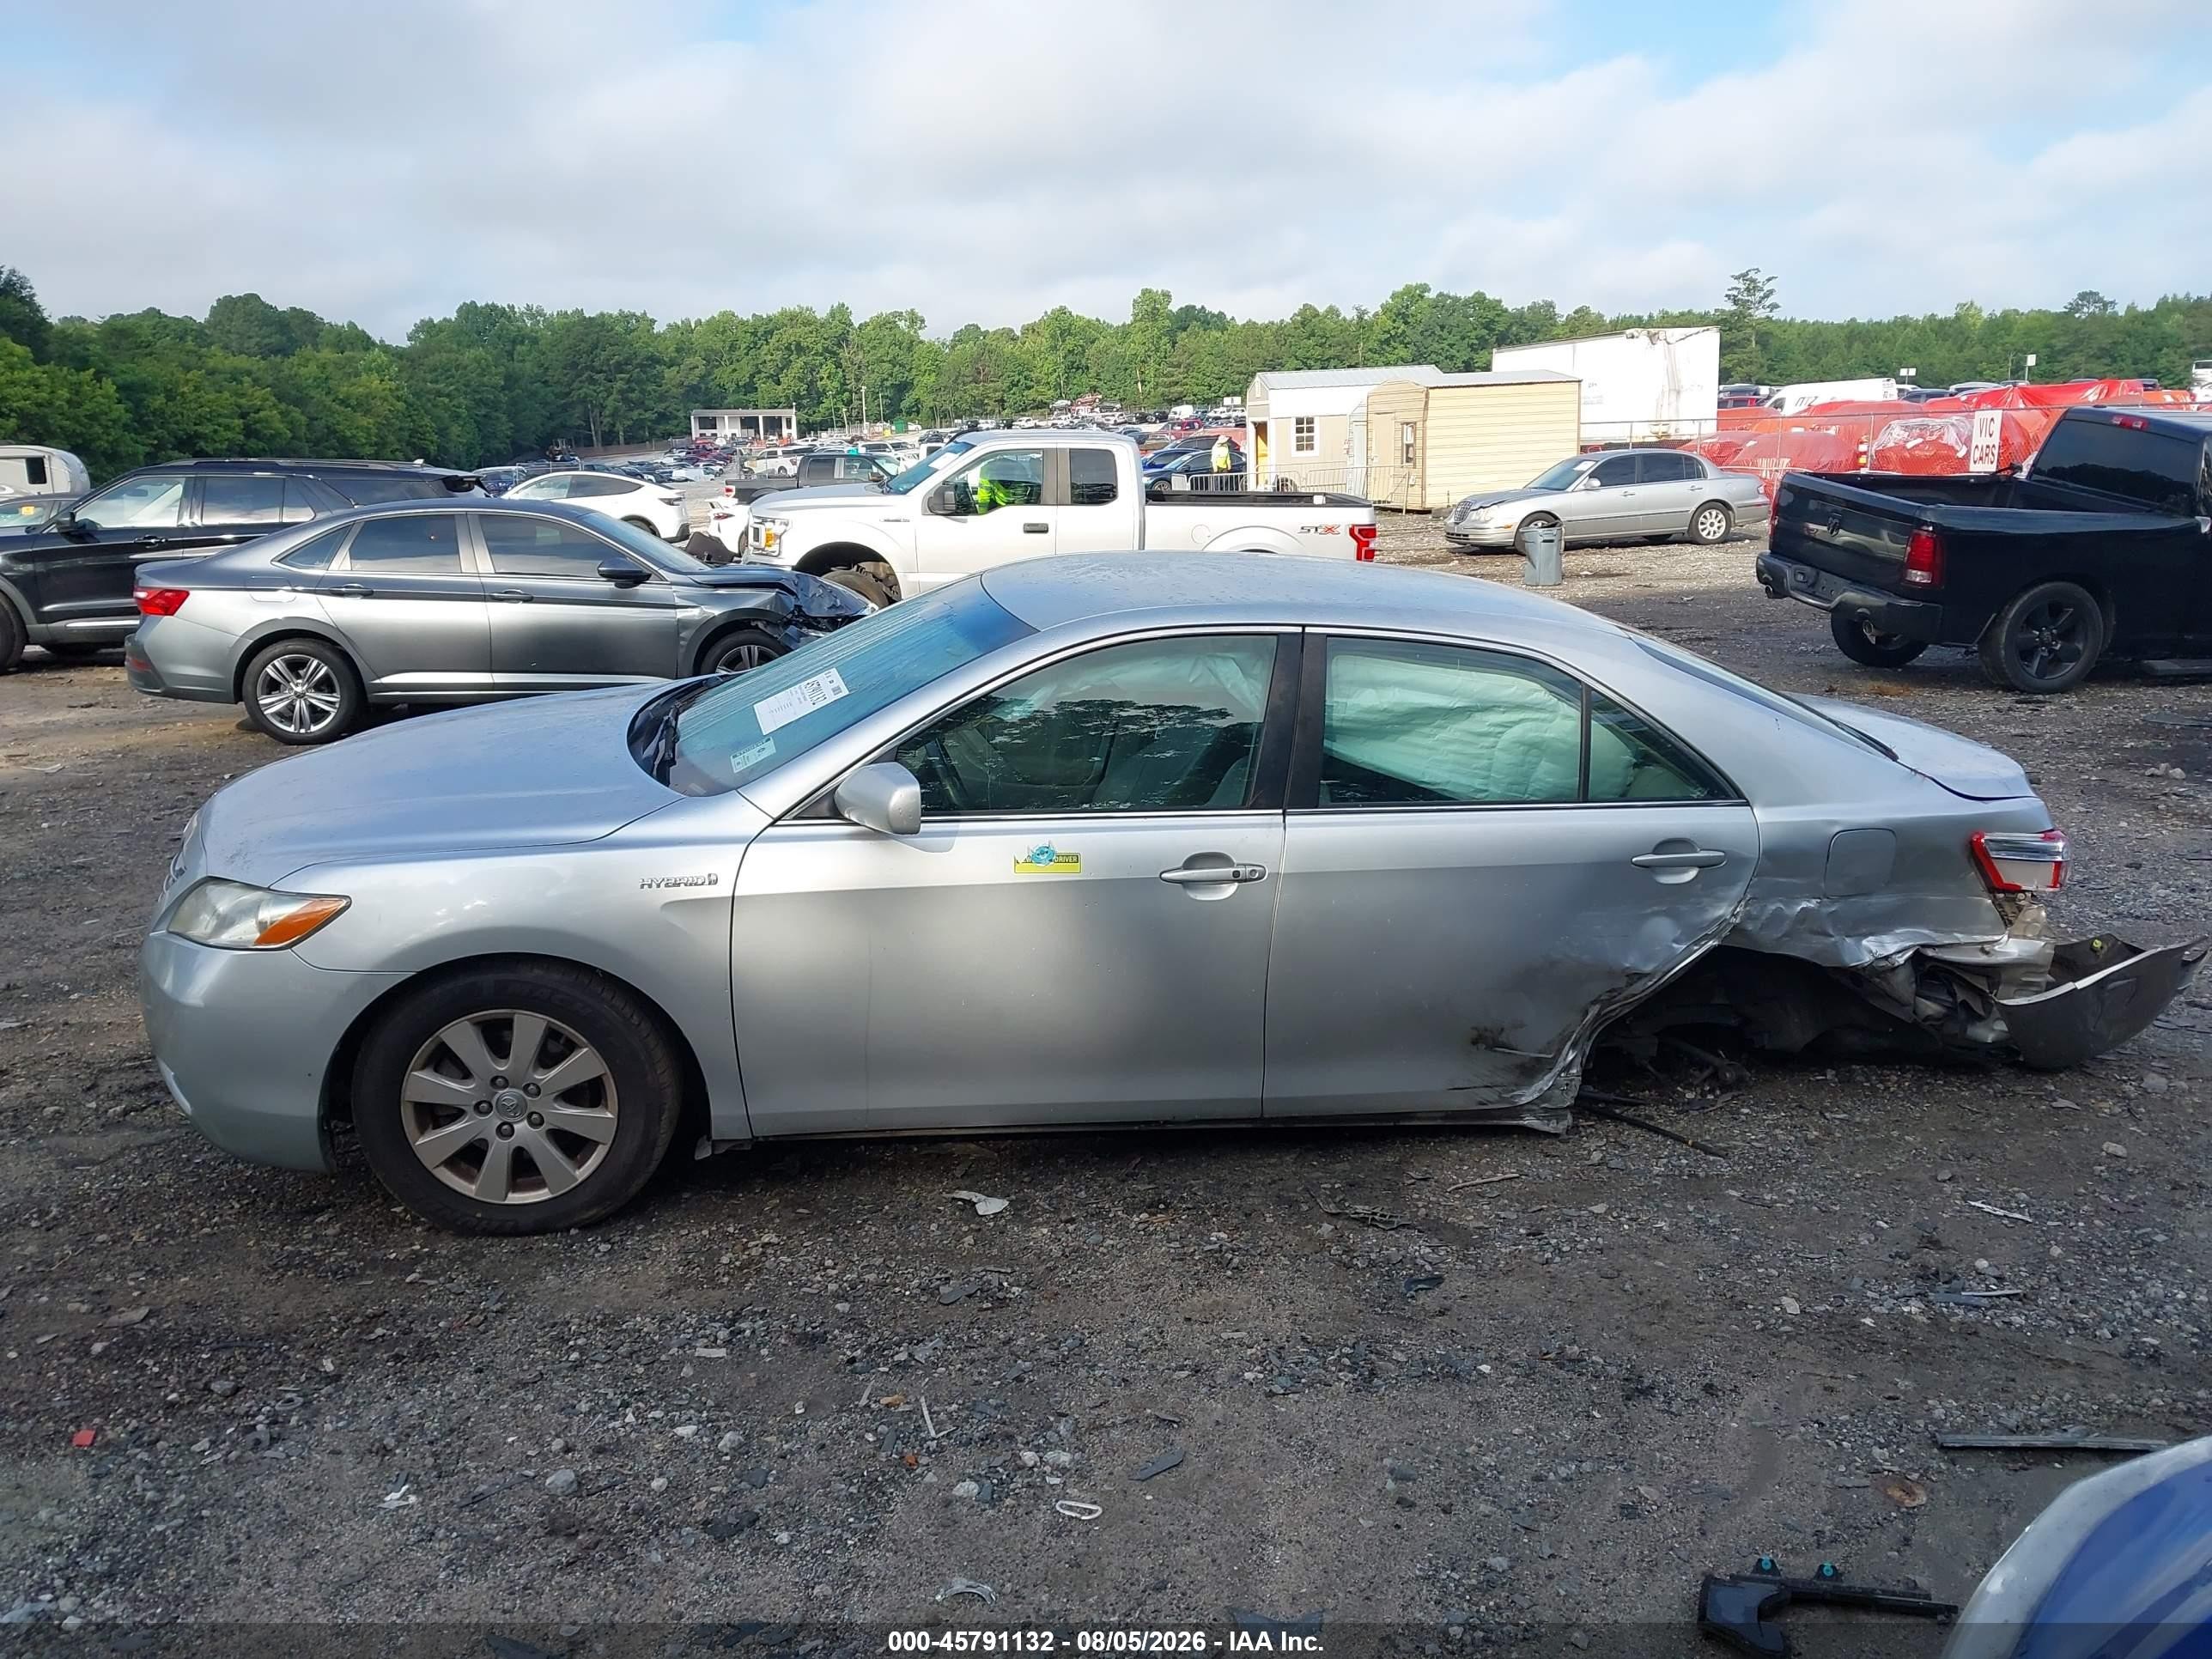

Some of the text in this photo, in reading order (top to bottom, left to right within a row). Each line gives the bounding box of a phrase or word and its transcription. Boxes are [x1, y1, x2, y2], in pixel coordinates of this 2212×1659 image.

[1979, 417, 1995, 438] VIC
[1973, 444, 1996, 465] CARS
[1298, 525, 1340, 535] STX
[640, 876, 705, 889] HYBRID
